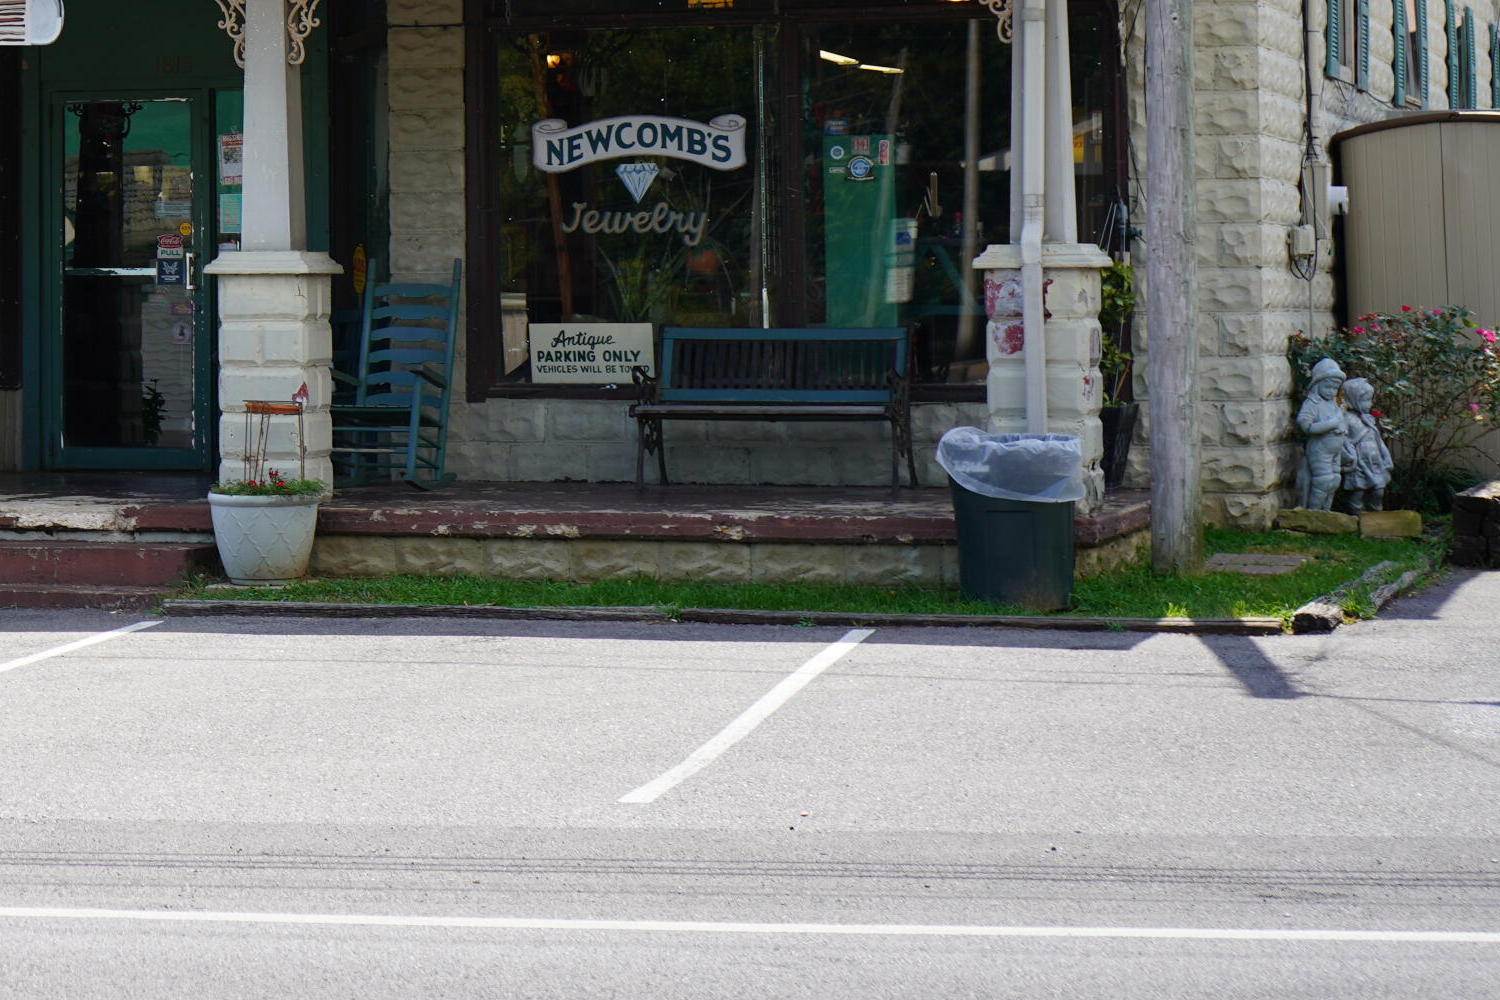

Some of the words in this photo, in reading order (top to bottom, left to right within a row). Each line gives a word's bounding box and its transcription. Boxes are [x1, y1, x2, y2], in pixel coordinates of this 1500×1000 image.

[546, 121, 732, 167] NEWCOMB'S
[561, 201, 710, 247] Jewelry
[550, 329, 616, 351] Antique
[537, 350, 596, 363] PARKING
[603, 350, 640, 363] ONLY
[537, 365, 578, 374] VEHICLES
[580, 364, 602, 374] WILL
[605, 364, 617, 374] BE
